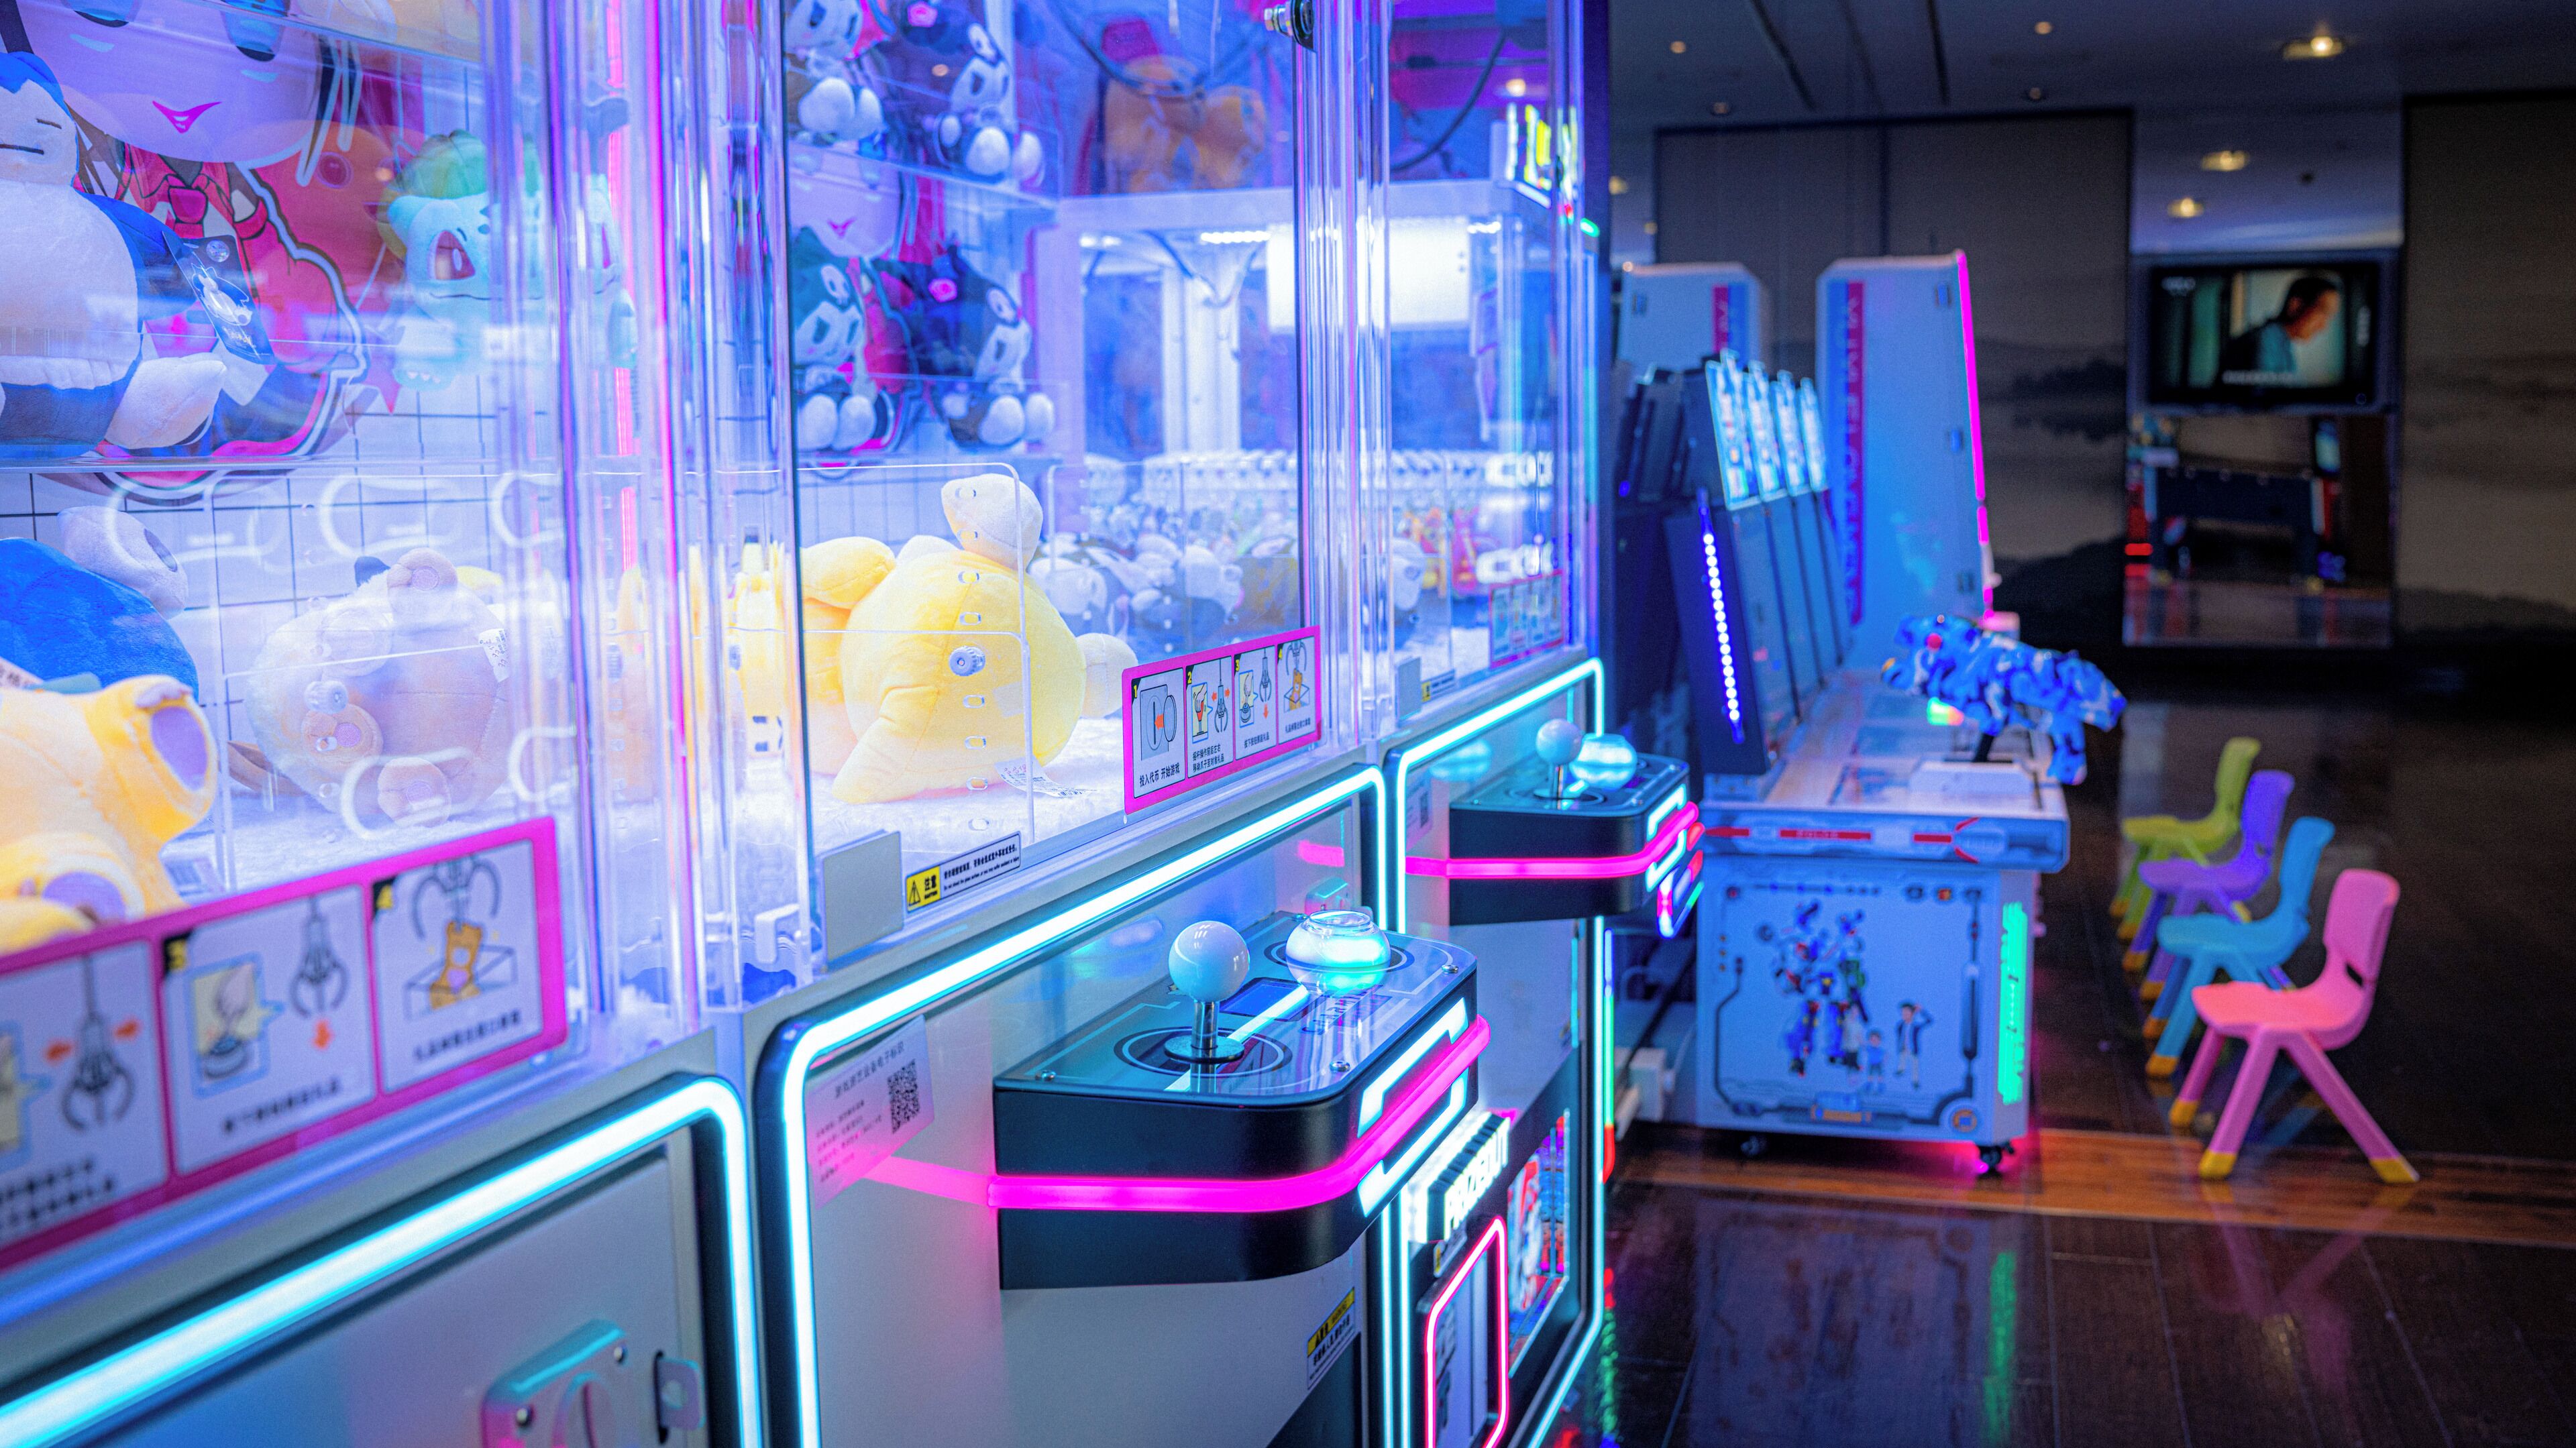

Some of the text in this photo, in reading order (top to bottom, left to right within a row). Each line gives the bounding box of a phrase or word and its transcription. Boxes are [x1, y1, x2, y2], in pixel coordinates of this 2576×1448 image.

[1279, 649, 1282, 660] 4
[1235, 660, 1239, 671] 3
[1187, 671, 1191, 683] 2
[1134, 685, 1137, 698] 1
[1140, 763, 1180, 787] 投入代币 开始游戏
[376, 880, 393, 910] 4
[168, 936, 189, 971] 3
